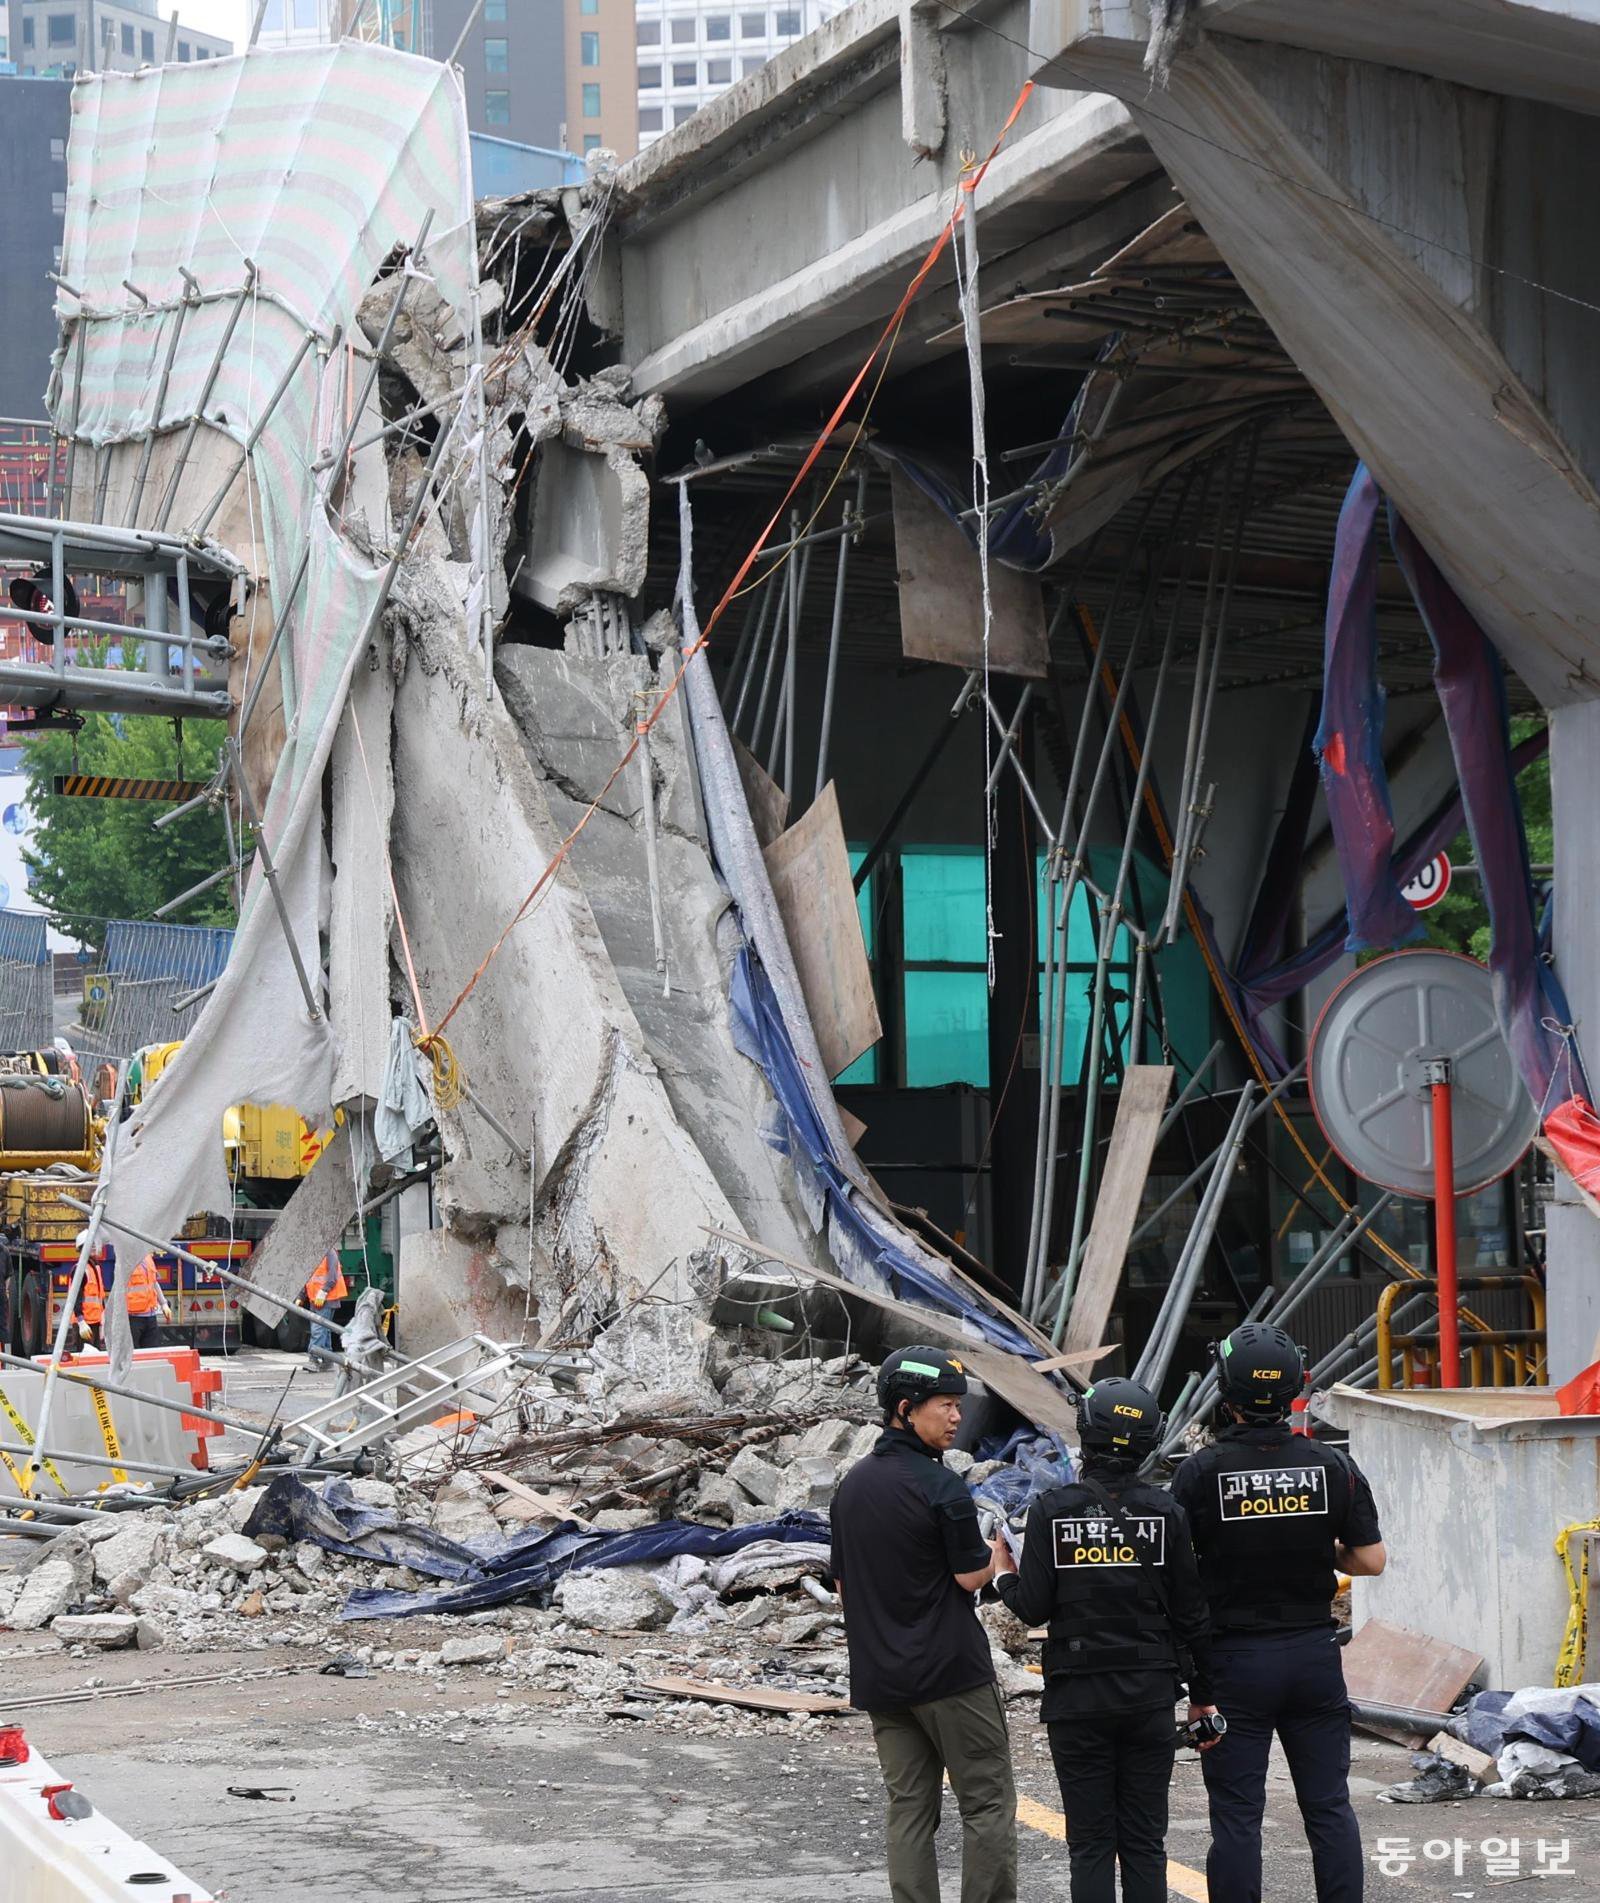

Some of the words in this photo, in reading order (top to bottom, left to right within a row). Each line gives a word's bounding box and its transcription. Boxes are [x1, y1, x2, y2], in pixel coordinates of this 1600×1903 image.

[1252, 1369, 1281, 1380] KCSI
[1113, 1404, 1143, 1419] KCSI
[1226, 1471, 1319, 1497] 과학수사
[1240, 1495, 1310, 1516] POLICE
[1074, 1546, 1140, 1564] POLIC
